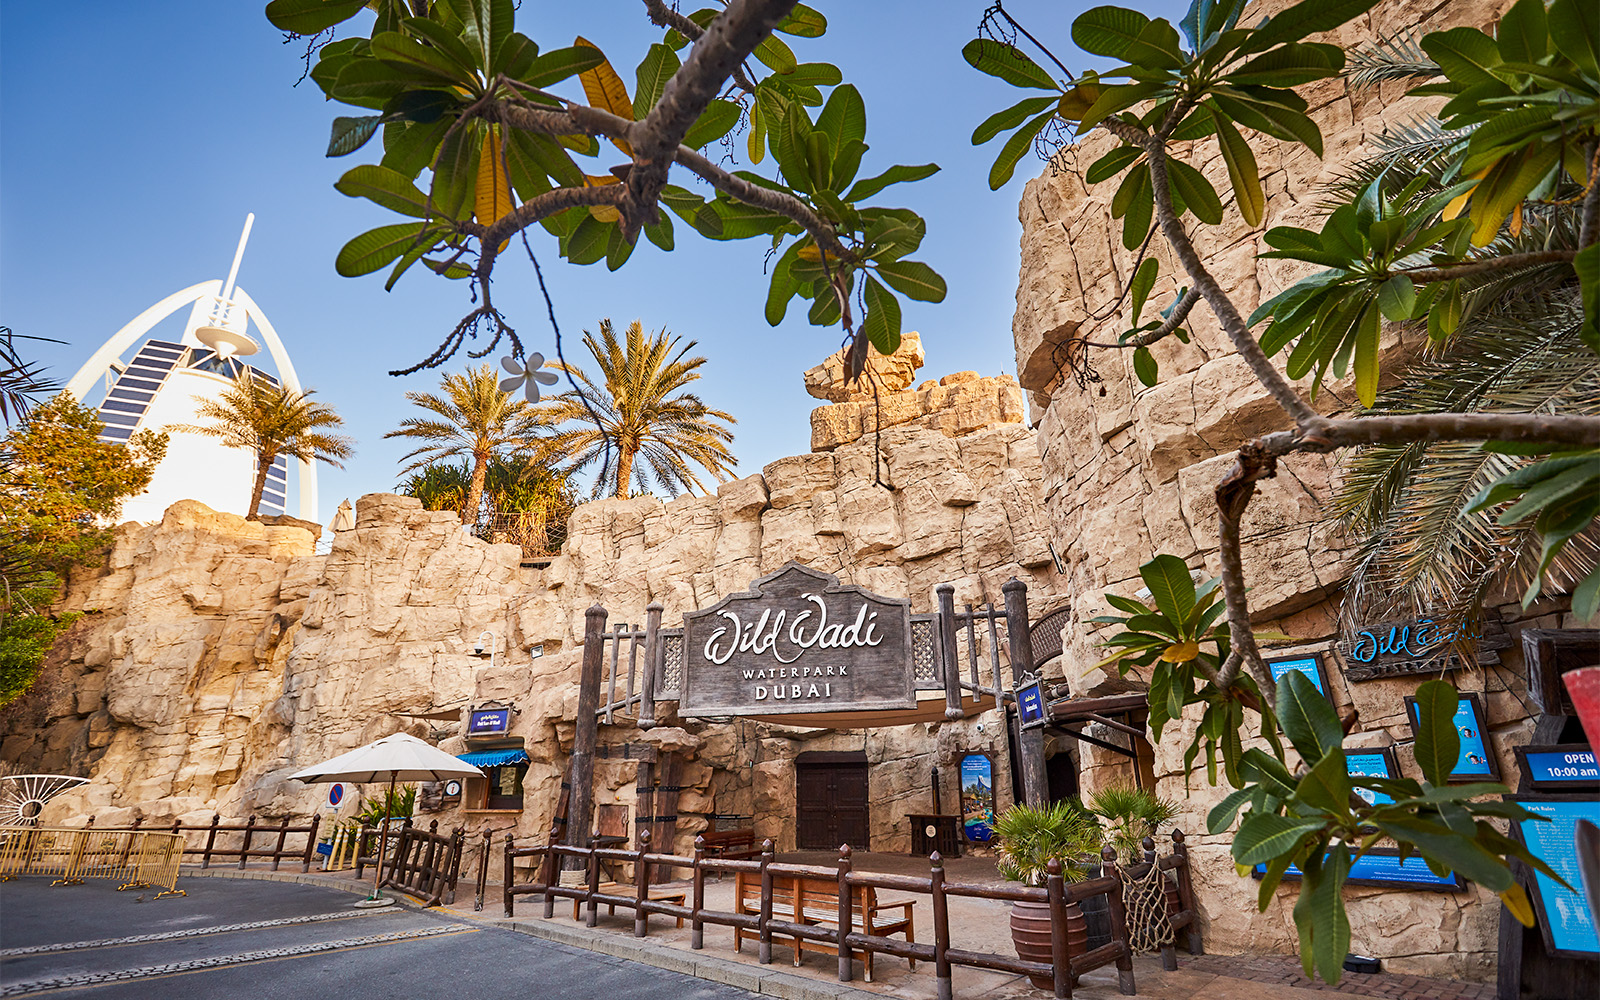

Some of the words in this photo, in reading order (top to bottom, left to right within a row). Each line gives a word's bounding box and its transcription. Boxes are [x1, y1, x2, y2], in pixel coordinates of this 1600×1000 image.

[704, 609, 804, 665] Wild
[789, 593, 884, 649] Wadi
[1353, 626, 1428, 662] Wild
[742, 665, 848, 680] WATERPARK
[755, 683, 831, 700] DUBAI
[1564, 753, 1594, 764] OPEN
[1547, 767, 1578, 777] 10:00
[1580, 768, 1598, 776] am
